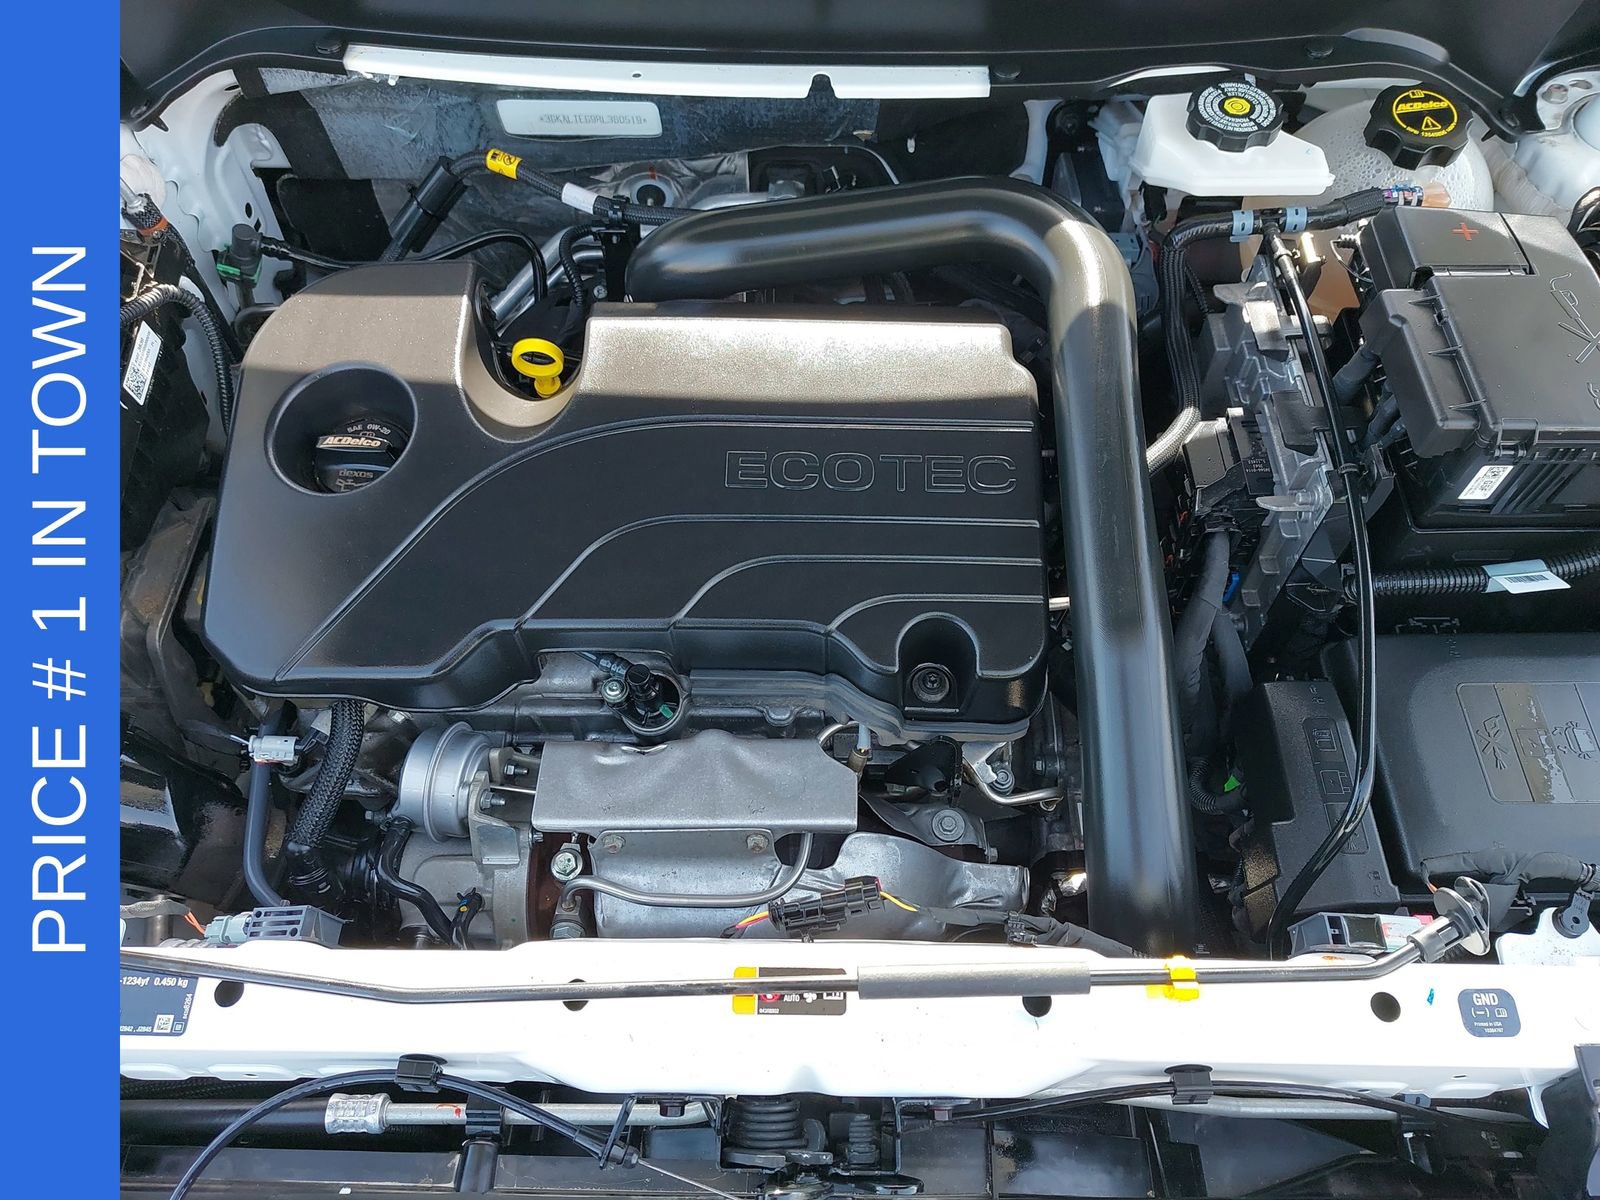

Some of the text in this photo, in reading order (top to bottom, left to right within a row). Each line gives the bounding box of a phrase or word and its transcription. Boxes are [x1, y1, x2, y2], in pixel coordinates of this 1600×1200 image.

[1397, 101, 1448, 110] ACDelco
[347, 424, 363, 433] SAE
[322, 436, 381, 447] ACDelco
[338, 469, 374, 479] dexos
[725, 450, 1016, 494] ECOTEC
[154, 977, 176, 986] 0.450
[178, 977, 189, 988] kg
[783, 994, 800, 1002] AUTO
[1472, 992, 1499, 1006] GND
